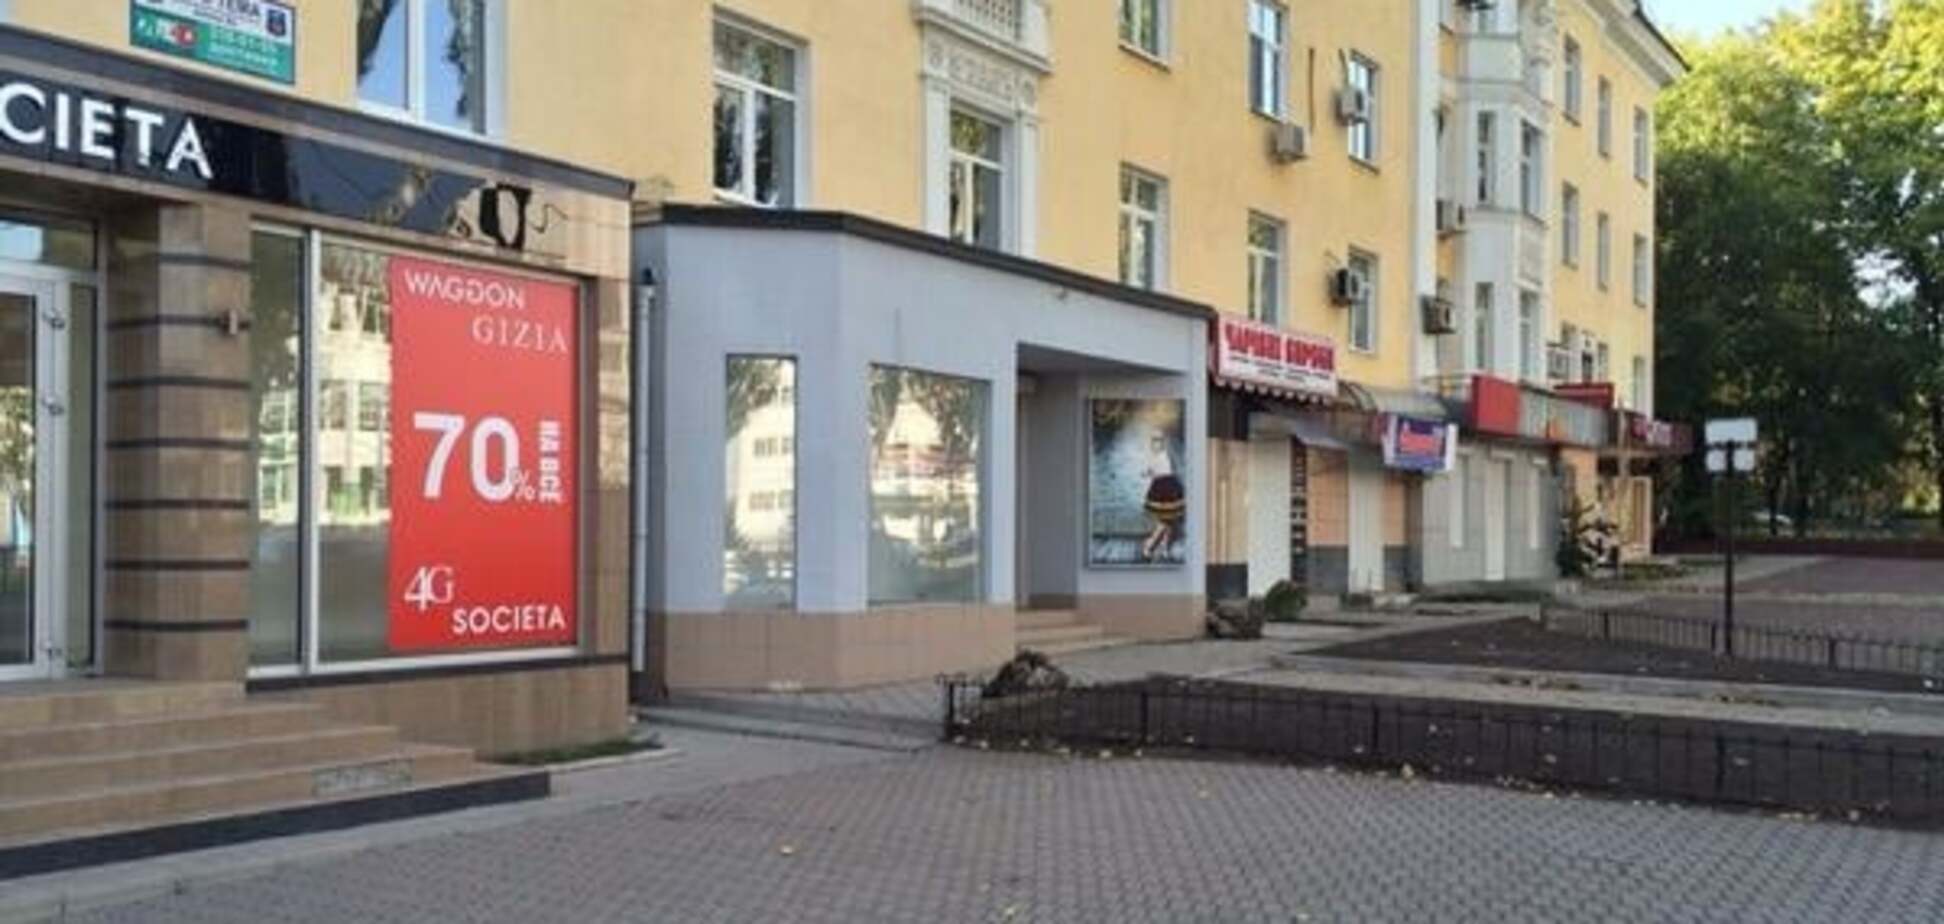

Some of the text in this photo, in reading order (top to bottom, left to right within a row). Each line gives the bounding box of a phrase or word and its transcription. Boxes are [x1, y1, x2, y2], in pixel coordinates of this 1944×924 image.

[0, 82, 213, 178] CIETA
[404, 269, 526, 310] WAGGON
[471, 315, 568, 354] GIZIA
[538, 419, 561, 452] НА
[404, 566, 454, 612] 4G
[453, 604, 566, 635] SOCIETA
